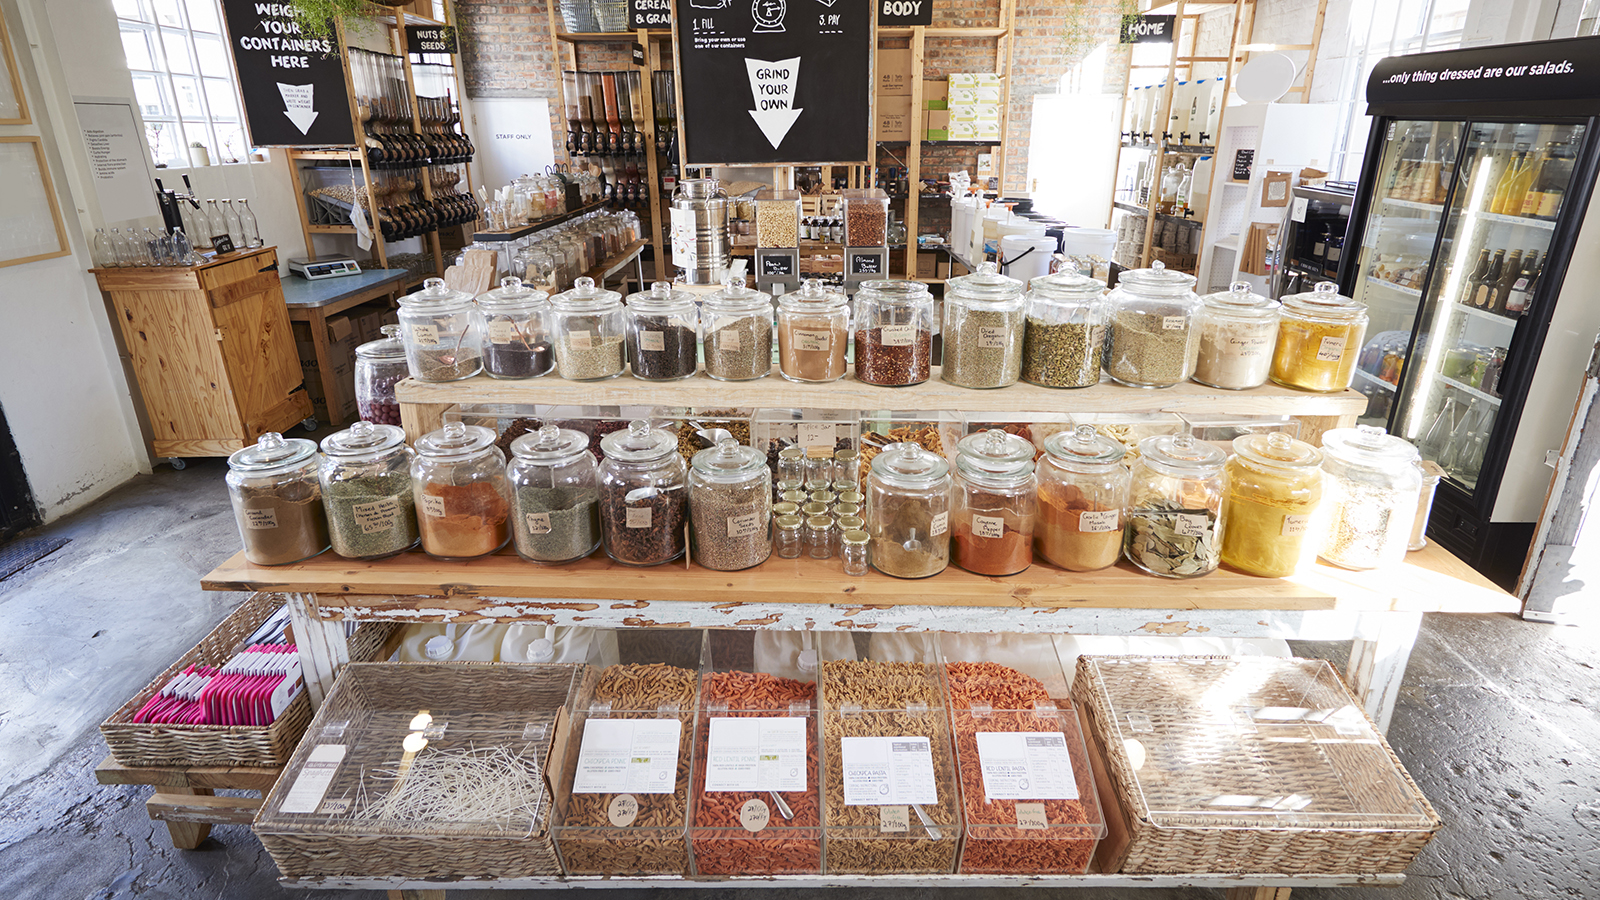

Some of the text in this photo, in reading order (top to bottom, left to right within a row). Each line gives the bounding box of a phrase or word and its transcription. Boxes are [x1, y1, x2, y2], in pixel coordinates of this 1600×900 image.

[883, 1, 922, 16] BODY
[702, 18, 714, 29] FILL
[819, 14, 841, 26] 3. PAY
[261, 20, 302, 34] YOUR
[1128, 22, 1165, 36] HOME
[416, 30, 438, 40] NUTS
[240, 36, 331, 52] CONTAINERS
[421, 41, 445, 50] SEEDS
[271, 55, 309, 68] HERE
[756, 68, 790, 80] GRIND
[1412, 70, 1438, 83] thing
[1439, 66, 1484, 80] dressed
[1483, 67, 1503, 78] are
[1505, 66, 1528, 77] our
[1529, 60, 1574, 75] salads.
[758, 84, 788, 95] YOUR
[760, 100, 788, 111] OWN
[976, 517, 997, 526] Cayenne
[302, 769, 333, 778] Spaghetti
